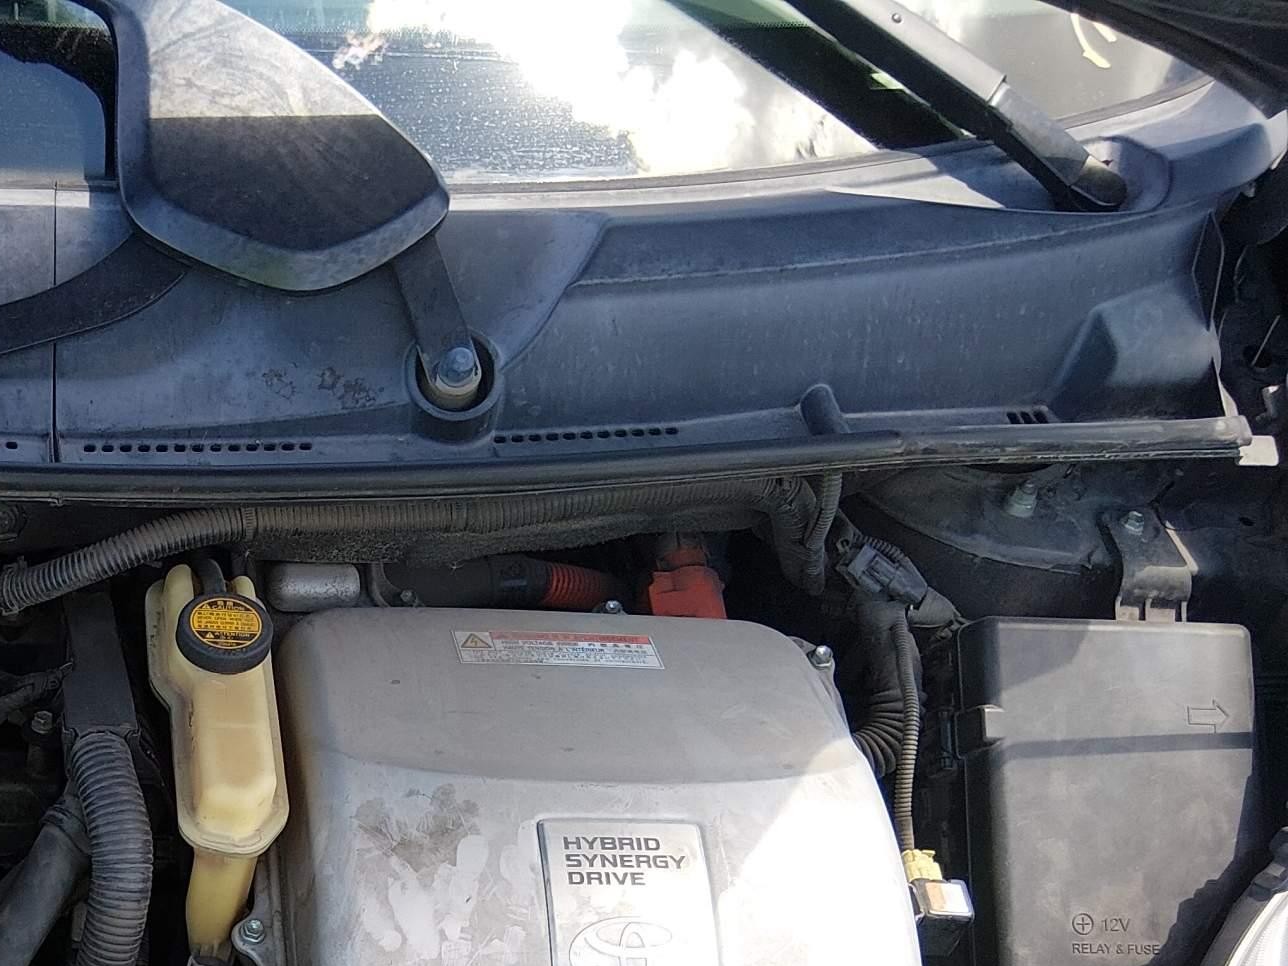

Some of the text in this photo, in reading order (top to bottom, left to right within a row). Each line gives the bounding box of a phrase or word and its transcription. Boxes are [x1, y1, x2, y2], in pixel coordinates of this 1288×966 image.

[563, 836, 661, 851] HYBRID
[565, 853, 686, 869] SYNERGY
[567, 871, 646, 886] DRIVE
[1101, 918, 1130, 932] 12V
[1072, 943, 1161, 955] RELAY & FUSE
